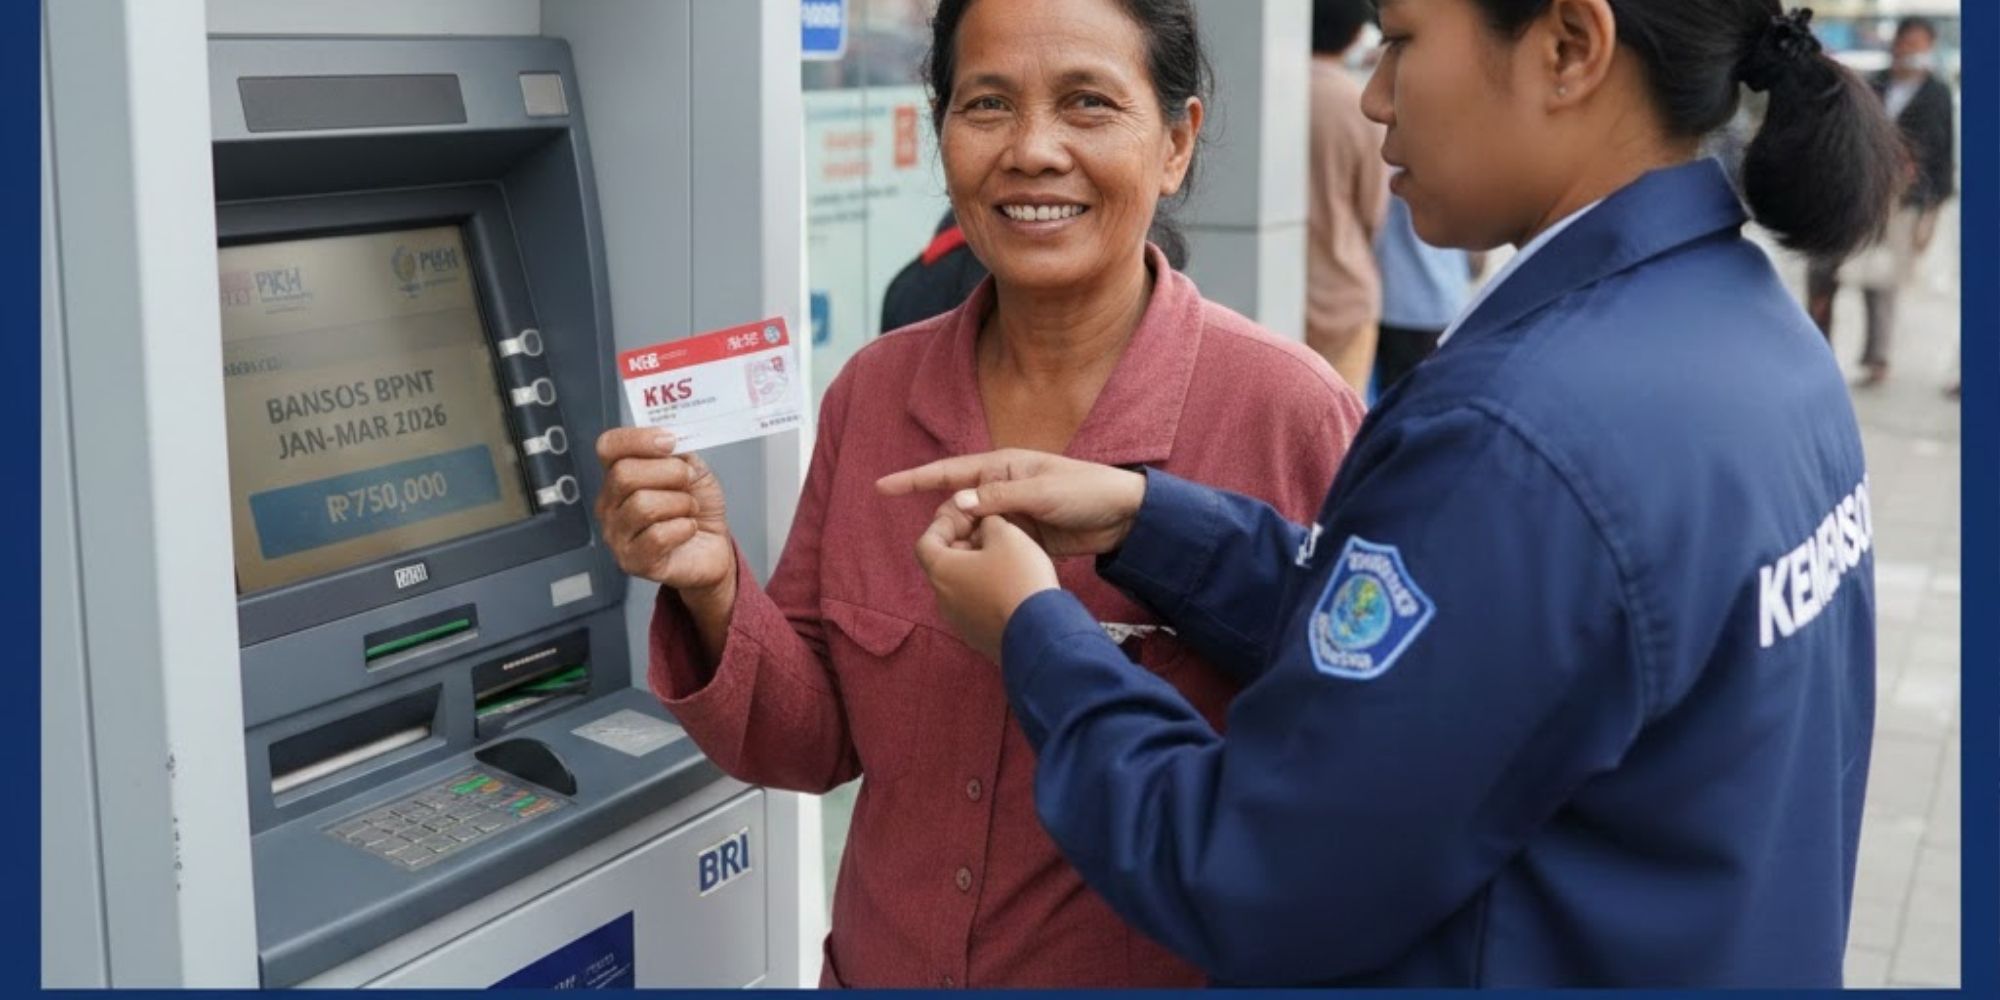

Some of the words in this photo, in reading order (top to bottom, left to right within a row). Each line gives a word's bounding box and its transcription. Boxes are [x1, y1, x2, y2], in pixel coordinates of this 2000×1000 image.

[266, 381, 370, 425] BANSOS
[374, 369, 436, 403] BPNT
[643, 377, 693, 408] KKS
[278, 416, 390, 460] JAN-MAR
[395, 403, 448, 436] 2026
[698, 833, 751, 893] BRI
